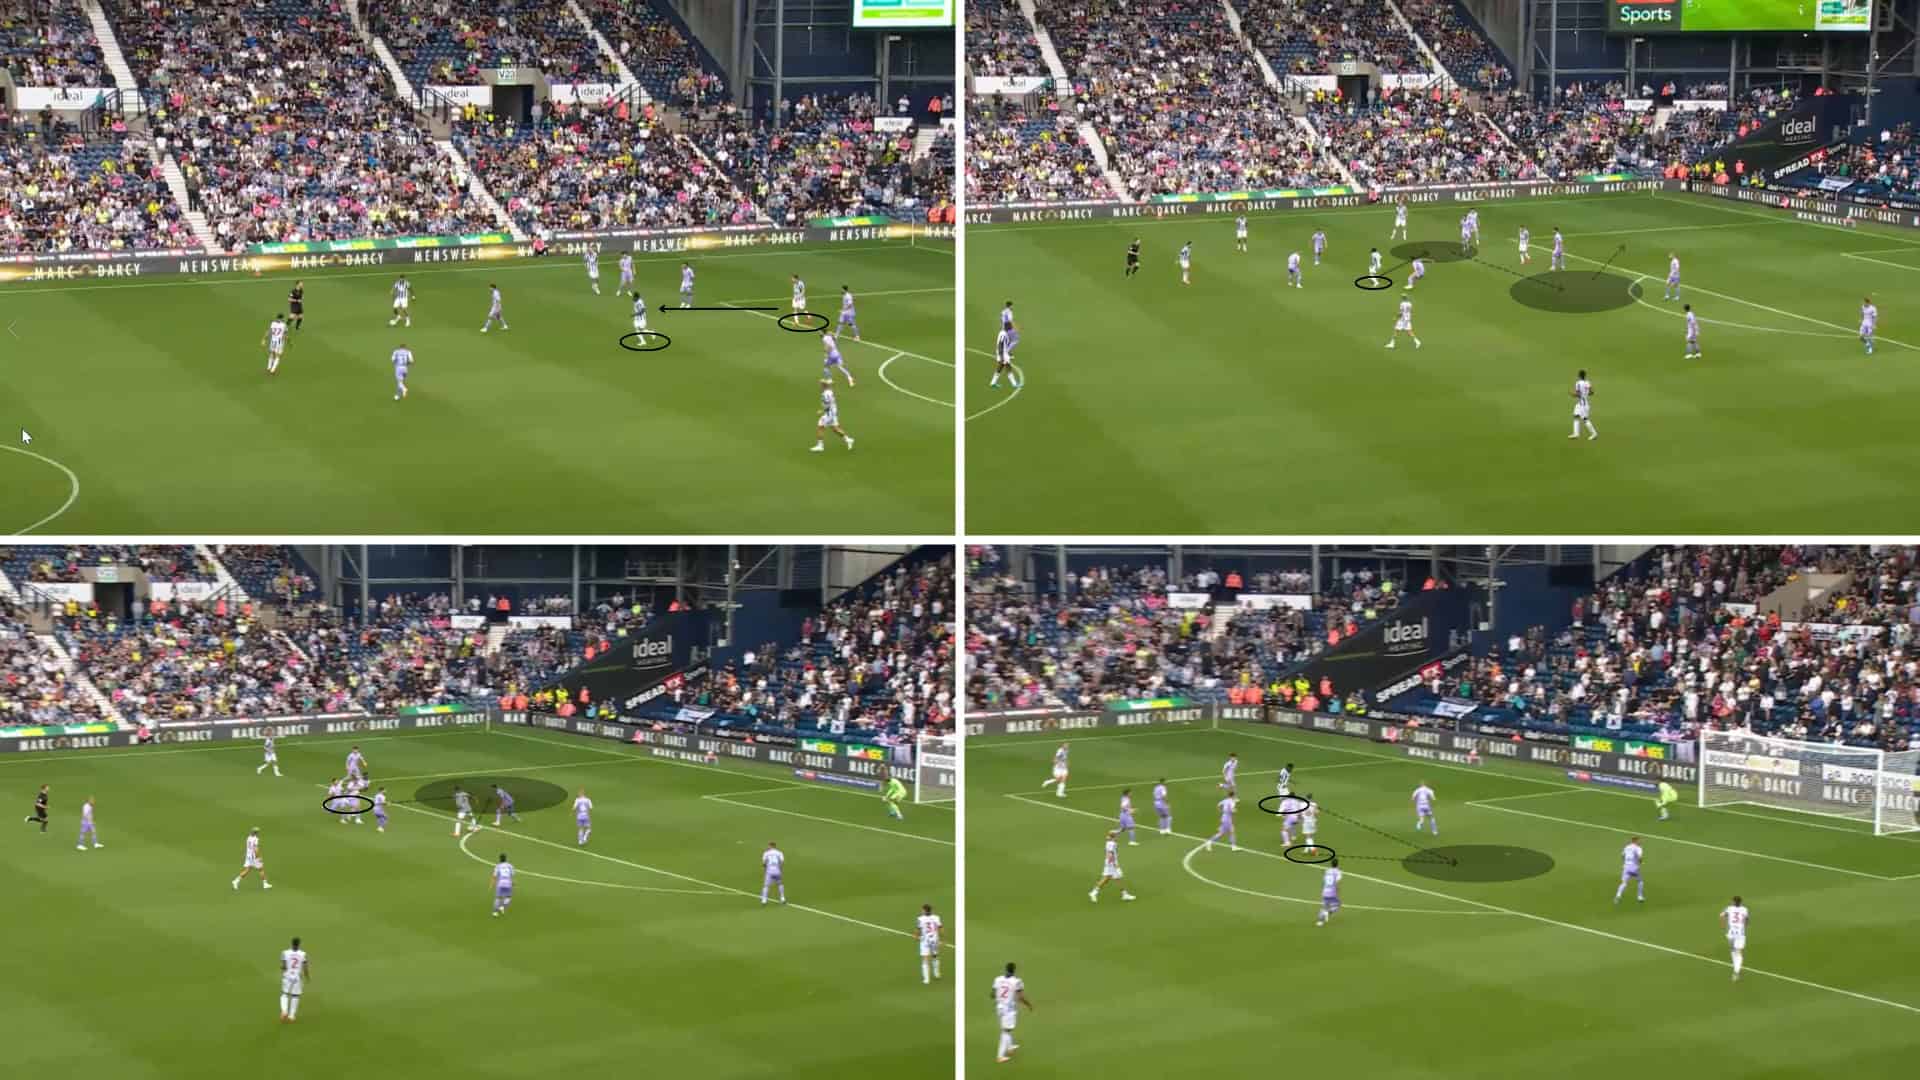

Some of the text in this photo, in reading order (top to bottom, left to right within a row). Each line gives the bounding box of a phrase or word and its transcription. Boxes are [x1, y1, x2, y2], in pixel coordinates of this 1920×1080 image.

[1620, 6, 1672, 25] Sports
[1781, 114, 1816, 135] ideal
[1454, 188, 1516, 200] MARC DARCY
[1531, 184, 1590, 196] MARC DARCY
[1604, 182, 1626, 192] MARC
[1293, 196, 1360, 208] MARC DARCY
[1412, 192, 1440, 202] DARCY
[1113, 205, 1188, 217] MARC DARCY
[1206, 201, 1277, 213] MARC DARCY
[1791, 198, 1837, 213] MARC DARCY
[1013, 208, 1093, 222] MARC DARCY
[1848, 206, 1867, 218] MARC
[1878, 210, 1901, 223] DARCY
[725, 233, 755, 246] MARC
[772, 231, 805, 244] DARCY
[291, 254, 327, 268] MARC
[346, 252, 385, 266] DARCY
[35, 265, 75, 280] MARC
[98, 262, 141, 277] DARCY
[1383, 616, 1428, 643] ideal
[632, 635, 673, 658] ideal
[769, 749, 833, 769] MARC DARCY
[1571, 751, 1601, 768] DARCY
[849, 760, 877, 775] MARC
[889, 766, 916, 782] DARC
[1618, 758, 1648, 774] MARC
[1663, 763, 1696, 781] DARCY
